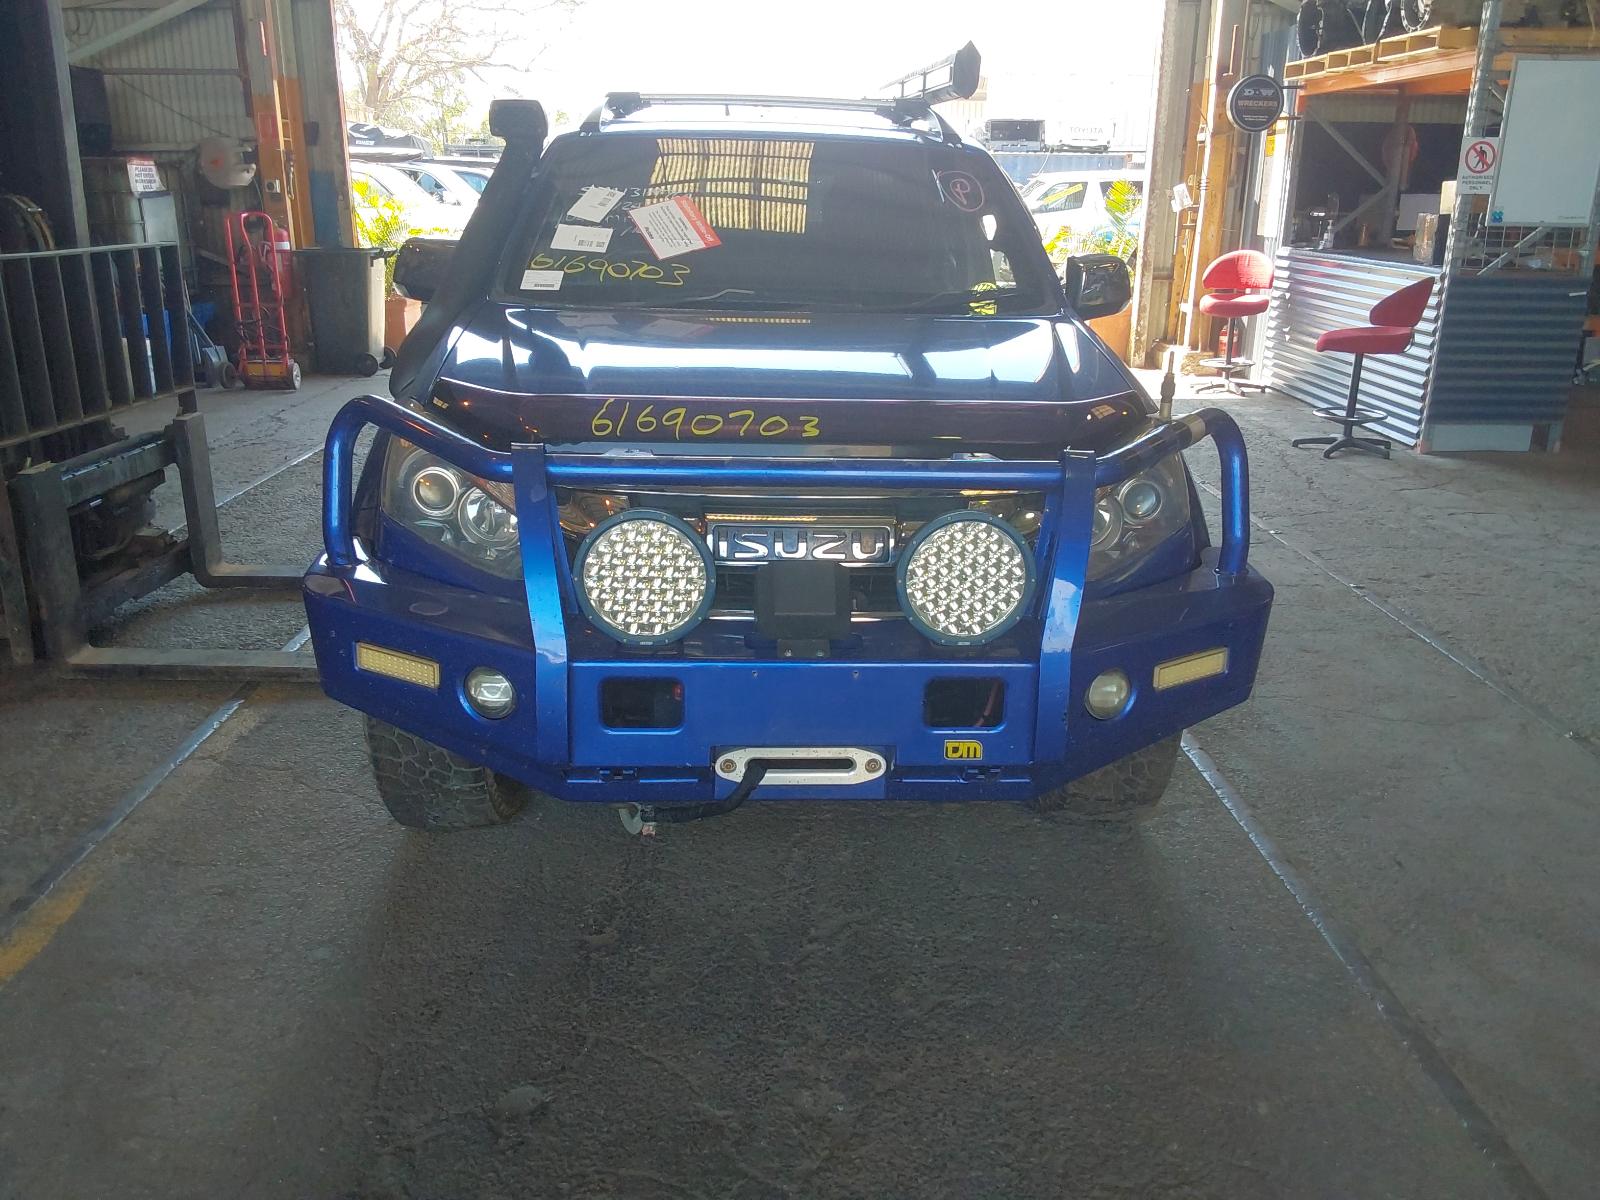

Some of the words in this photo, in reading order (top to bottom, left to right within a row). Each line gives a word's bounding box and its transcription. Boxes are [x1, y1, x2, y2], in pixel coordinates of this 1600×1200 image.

[1237, 99, 1278, 107] WRECKERS
[1069, 126, 1104, 135] TOYOTA
[530, 253, 691, 286] 61690703
[591, 397, 821, 441] 61690703
[718, 530, 884, 560] ISUZU
